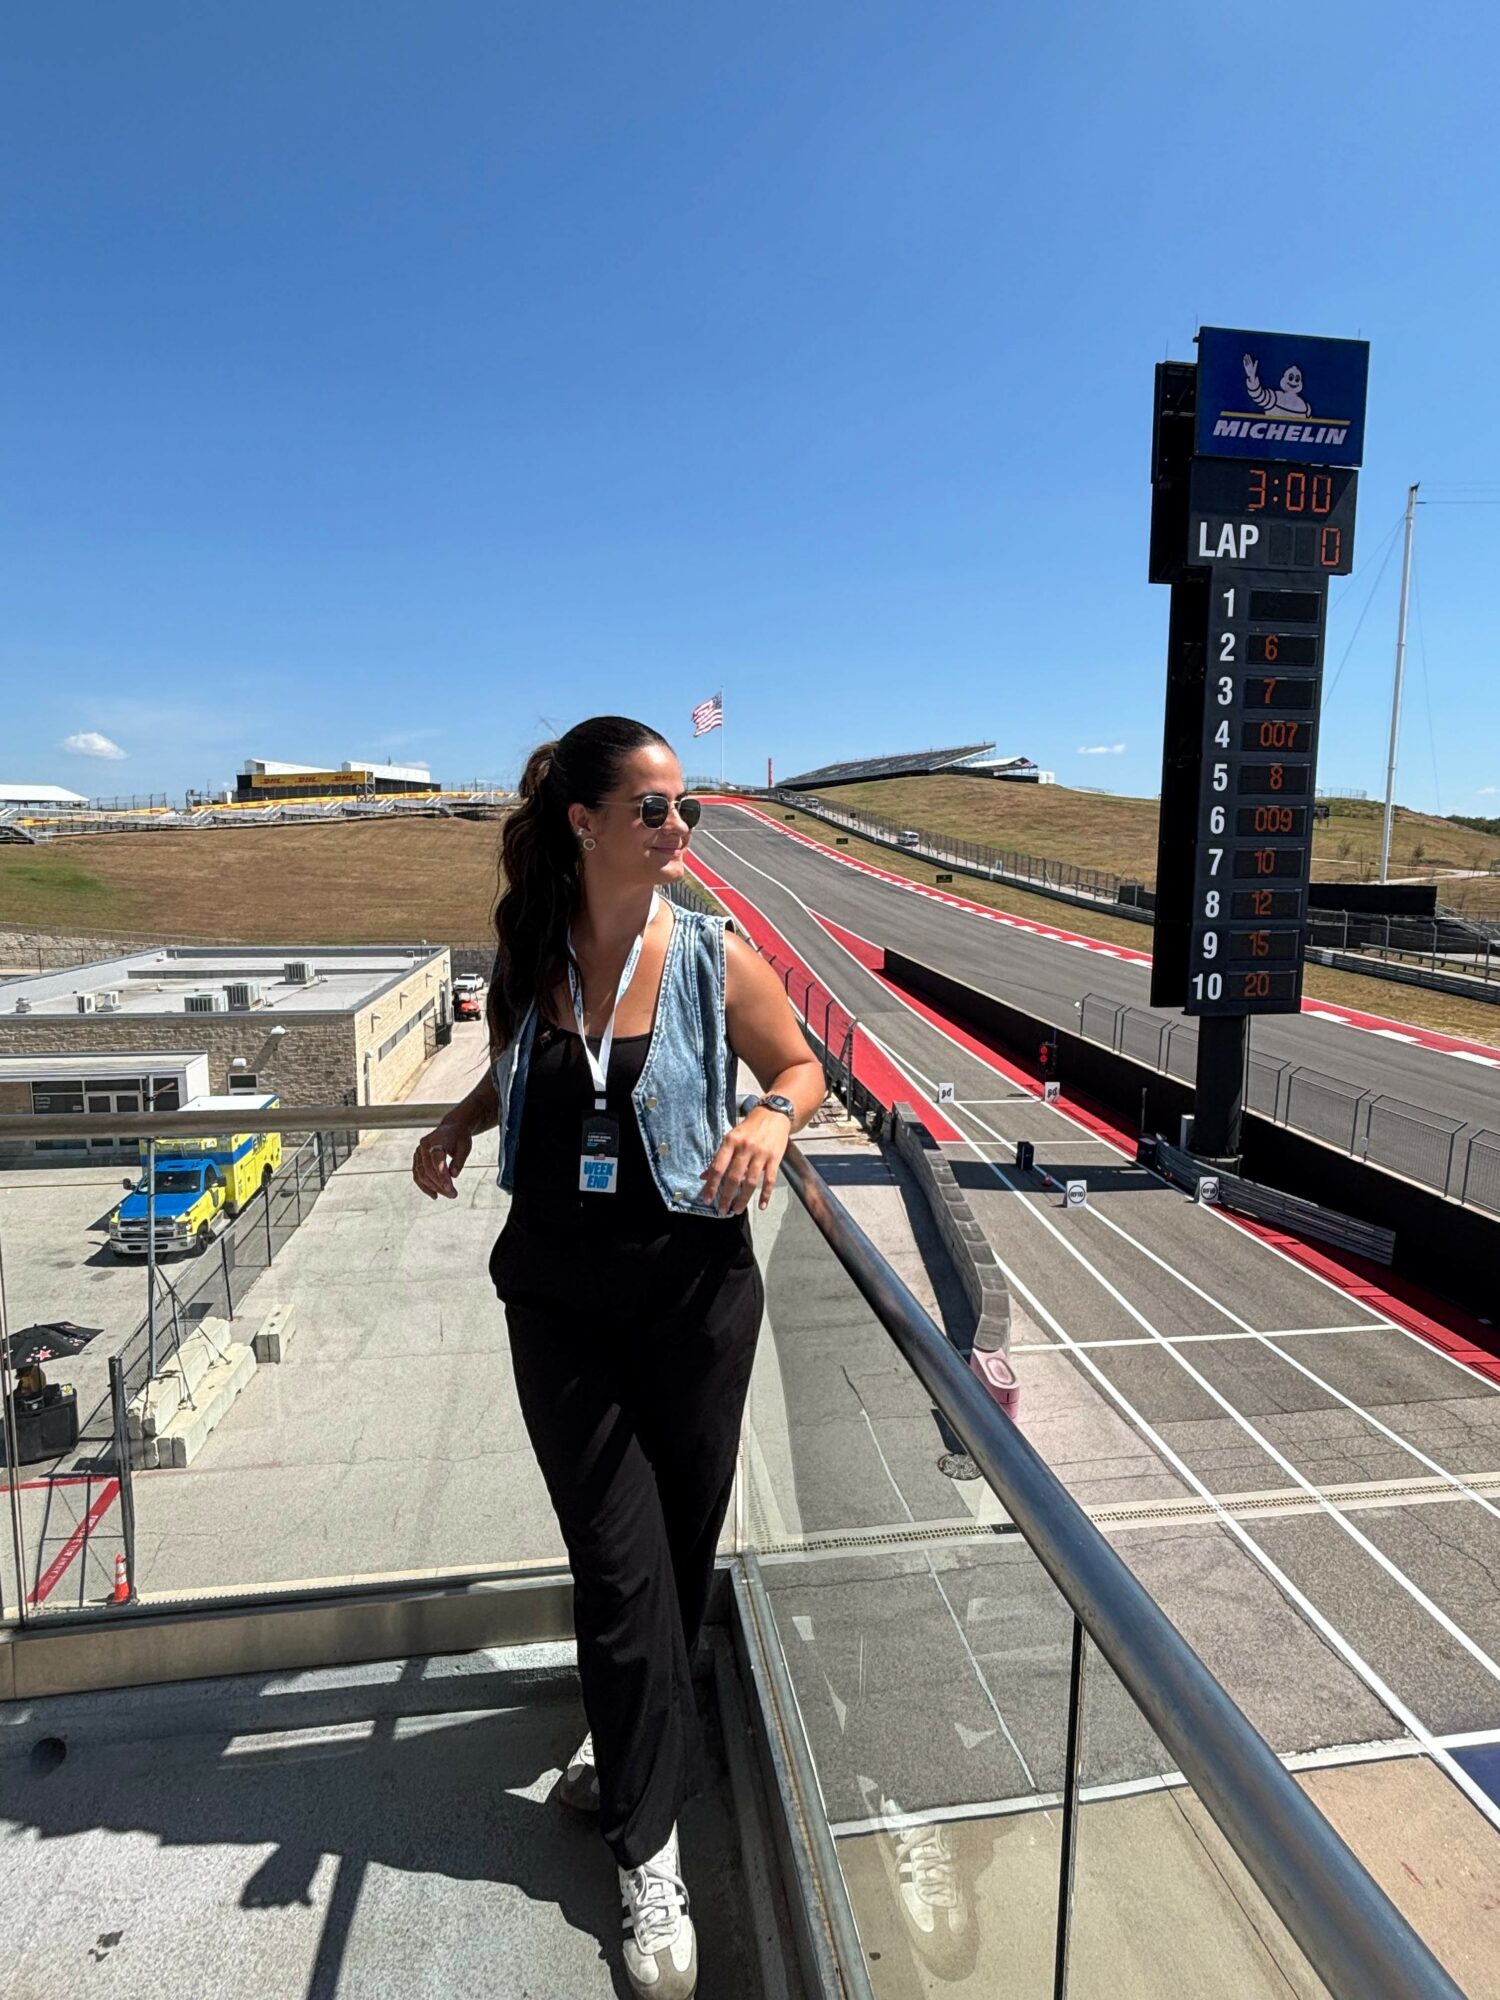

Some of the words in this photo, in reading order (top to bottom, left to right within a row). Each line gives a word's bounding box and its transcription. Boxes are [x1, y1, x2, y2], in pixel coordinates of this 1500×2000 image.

[1212, 420, 1348, 445] MICHELIN
[1248, 470, 1332, 512] 3:00
[1198, 521, 1260, 559] LAP
[1320, 527, 1341, 566] 0
[1222, 588, 1235, 618] 1
[1220, 632, 1235, 662] 2
[1264, 635, 1278, 661] 6
[1217, 676, 1233, 706] 3
[1263, 677, 1277, 705] 7
[1214, 720, 1230, 748] 4
[1260, 721, 1298, 748] 007
[263, 777, 282, 785] DHL
[297, 776, 317, 784] DHL
[1212, 763, 1228, 792] 5
[1269, 764, 1283, 790] 8
[1210, 806, 1226, 835] 6
[1254, 807, 1293, 833] 009
[1208, 848, 1223, 876] 7
[1254, 849, 1275, 874] 10
[1205, 890, 1220, 919] 8
[1251, 891, 1272, 916] 12
[1203, 931, 1218, 959] 9
[1248, 932, 1269, 956] 15
[1192, 973, 1222, 1001] 10
[1244, 972, 1270, 997] 20
[583, 1161, 616, 1176] WEEK
[586, 1175, 610, 1189] END
[1070, 1190, 1084, 1198] RFID
[1202, 1187, 1216, 1195] RFID
